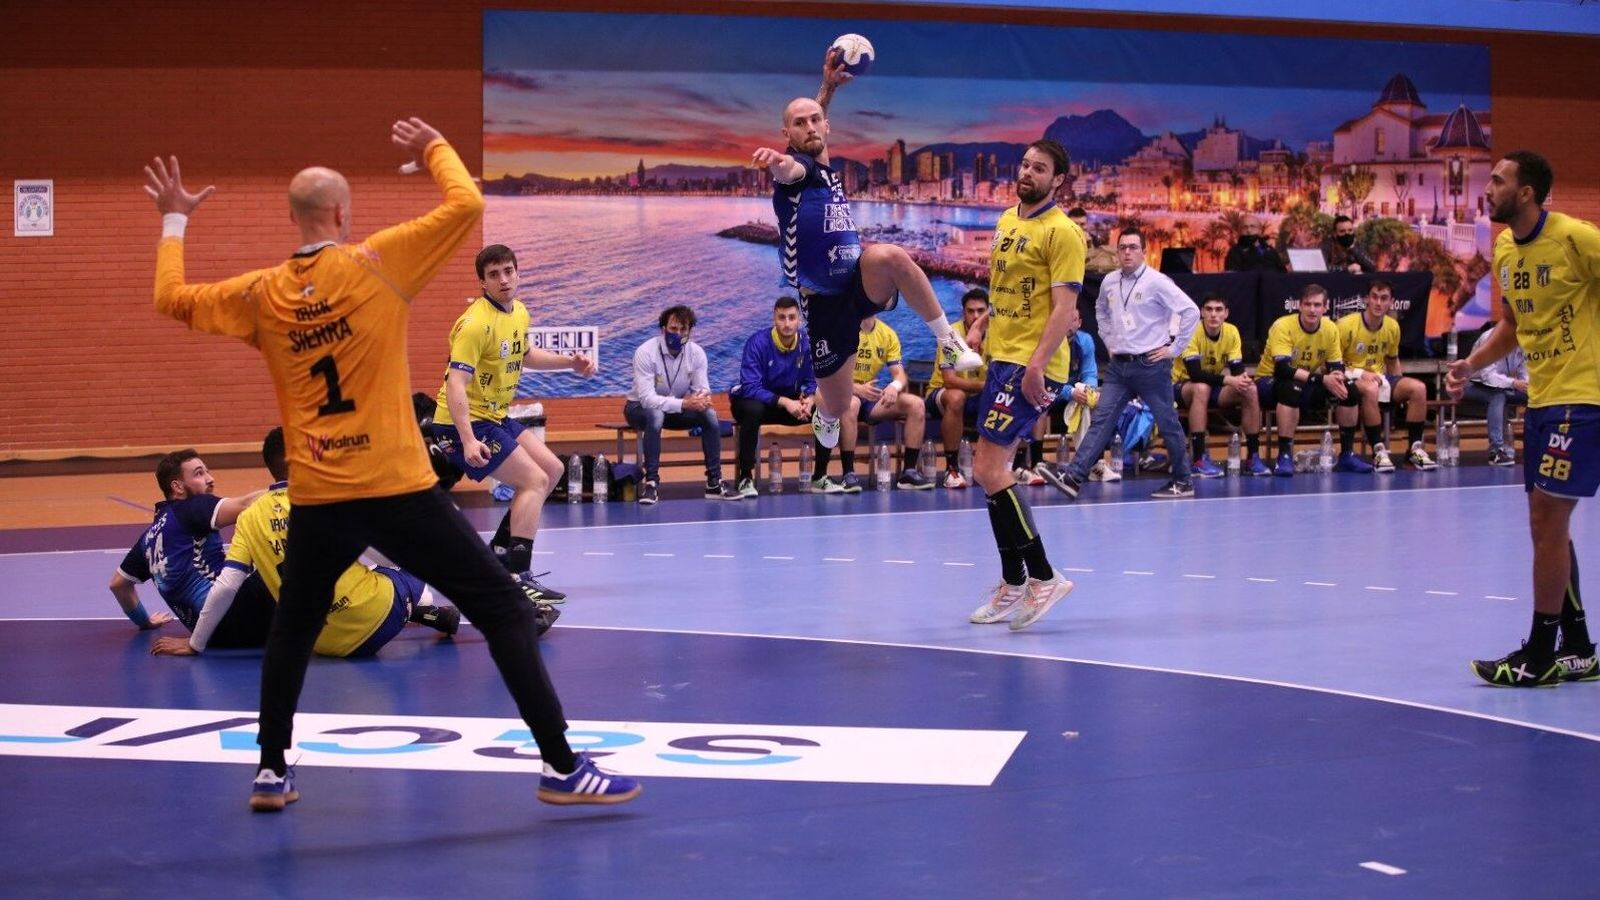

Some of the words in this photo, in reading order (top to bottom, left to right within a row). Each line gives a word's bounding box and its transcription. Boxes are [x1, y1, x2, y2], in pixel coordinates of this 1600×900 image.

[1513, 272, 1531, 289] 28
[288, 316, 353, 353] SIERRA
[526, 331, 593, 349] BENI
[858, 348, 872, 359] 25
[310, 354, 356, 416] 1
[995, 392, 1015, 407] DV
[984, 409, 1014, 432] 27
[1548, 433, 1573, 451] DV
[1538, 453, 1572, 481] 28
